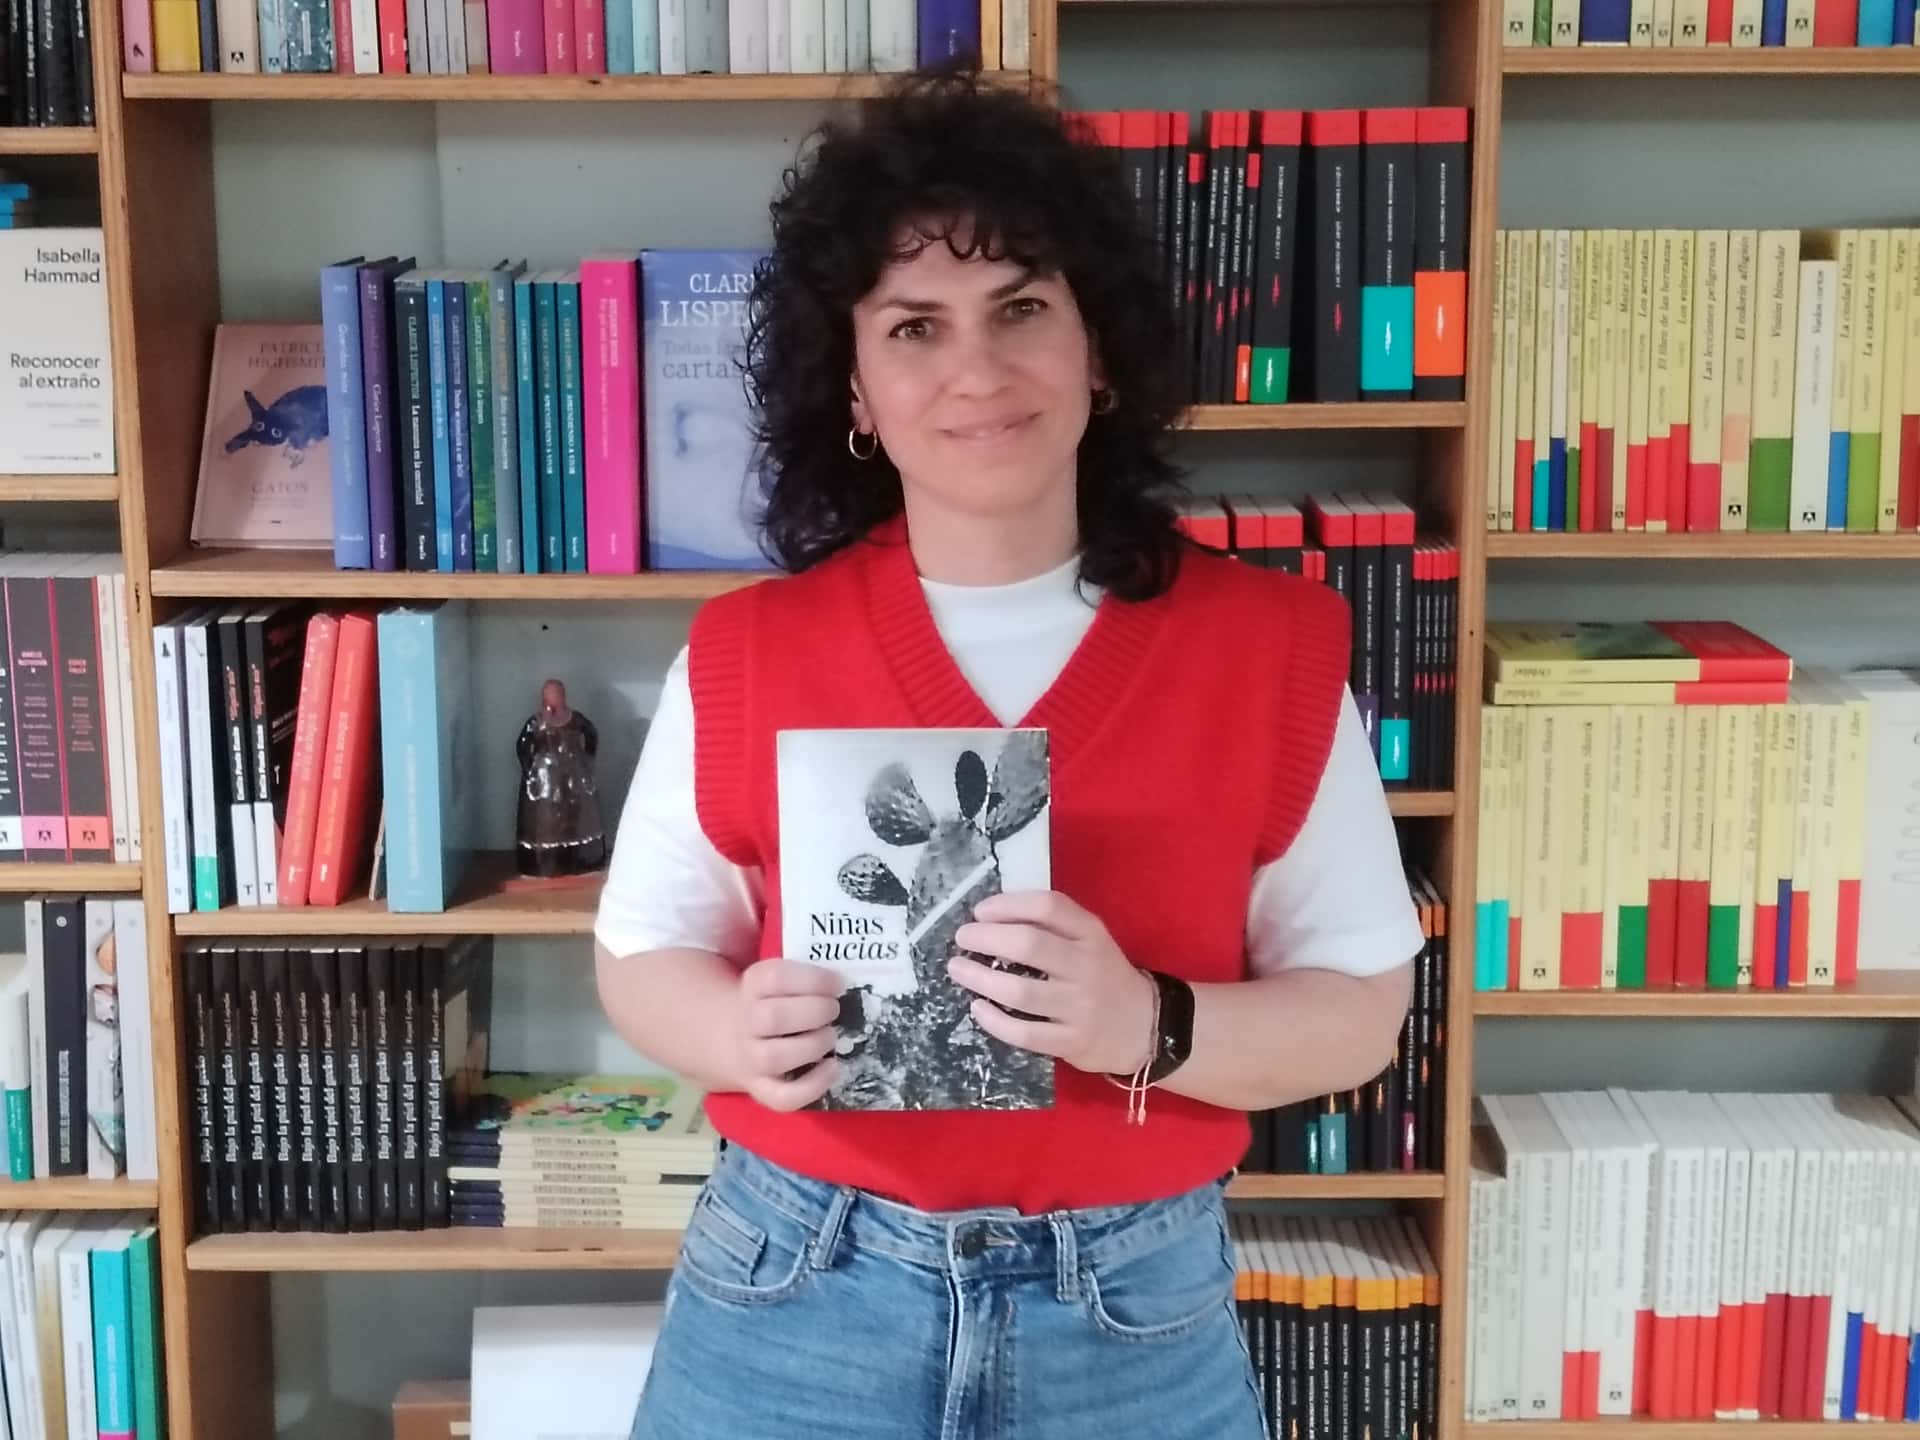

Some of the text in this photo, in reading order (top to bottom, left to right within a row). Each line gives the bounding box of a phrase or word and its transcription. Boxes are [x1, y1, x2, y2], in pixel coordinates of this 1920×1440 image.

[37, 247, 100, 264] Isabella
[25, 267, 100, 284] Hammad
[659, 299, 748, 328] LISPE
[260, 341, 324, 354] PATRICI
[11, 353, 100, 369] Reconocer
[248, 355, 326, 369] HIGHSMIT
[19, 373, 100, 389] al extraño
[811, 912, 884, 936] Niñas
[809, 937, 899, 961] sucias
